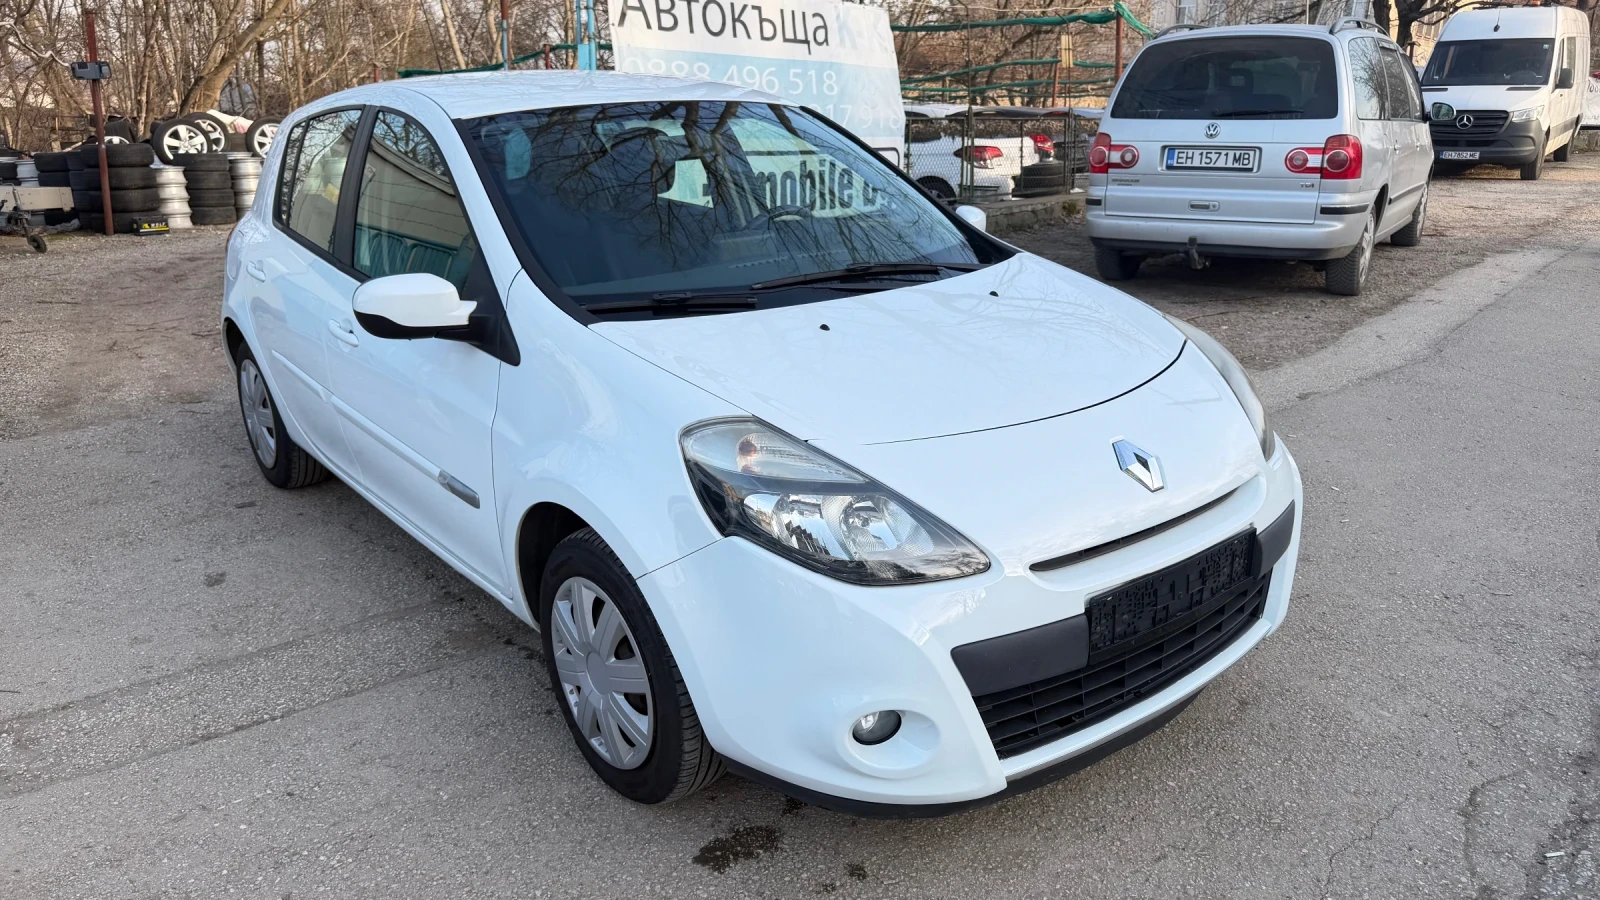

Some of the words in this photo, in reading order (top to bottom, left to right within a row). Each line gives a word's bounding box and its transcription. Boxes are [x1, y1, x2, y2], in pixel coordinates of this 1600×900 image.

[618, 0, 830, 55] Автокъща
[722, 65, 779, 93] 496
[789, 69, 838, 95] 518
[1176, 151, 1194, 164] EH
[1198, 152, 1229, 165] 1571
[1232, 152, 1251, 166] MB
